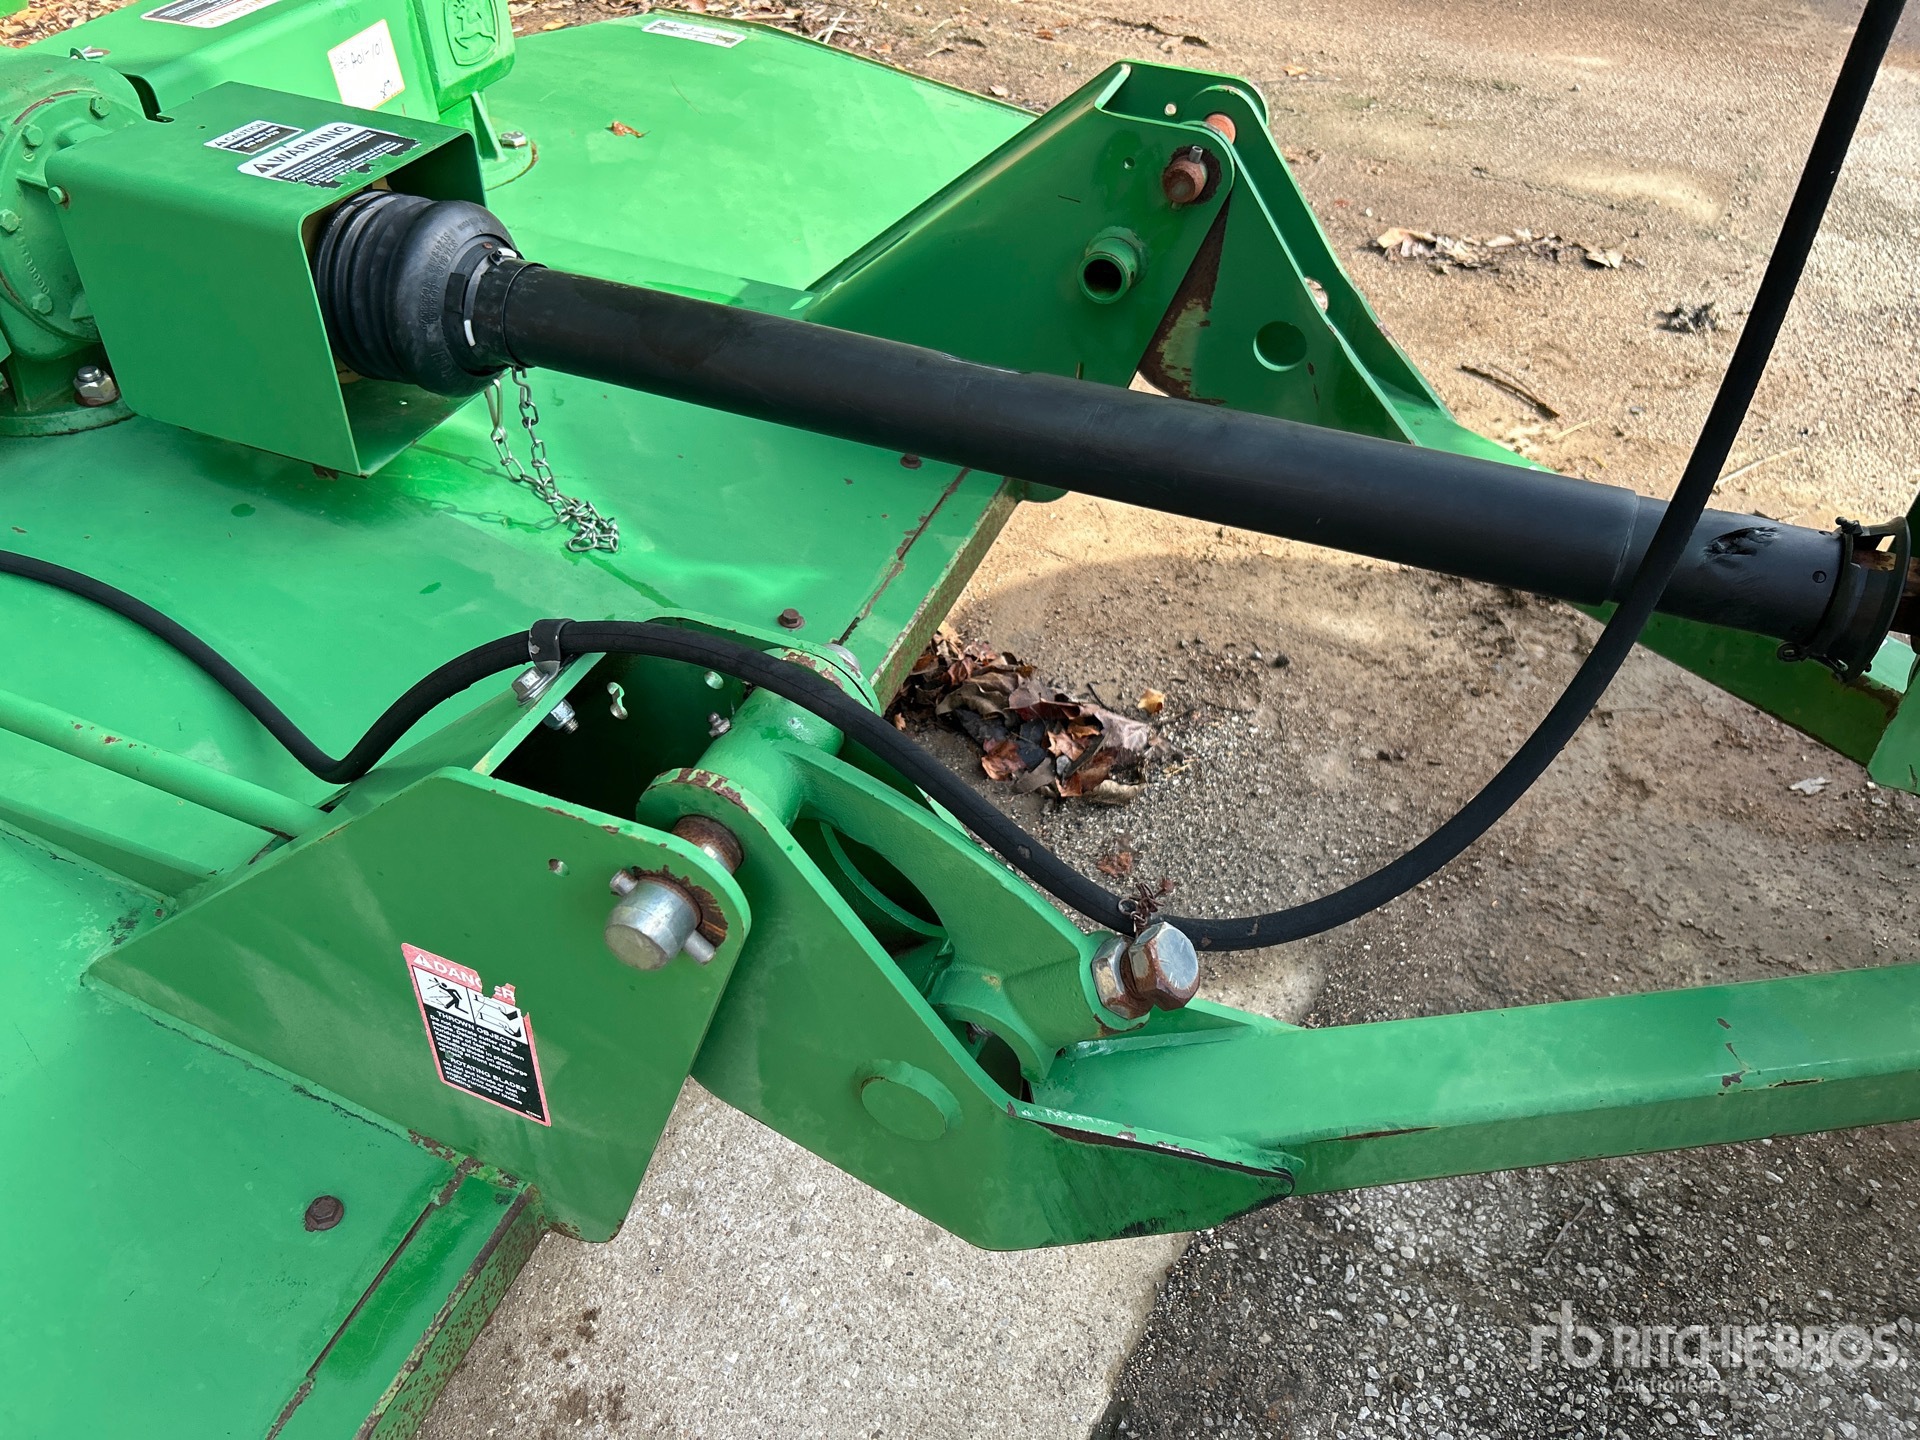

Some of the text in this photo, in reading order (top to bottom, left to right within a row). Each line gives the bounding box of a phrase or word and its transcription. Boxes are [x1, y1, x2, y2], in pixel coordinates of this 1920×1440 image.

[225, 122, 267, 141] CAUTION
[267, 125, 354, 163] WARNING
[429, 1014, 514, 1051] Do not operate cutter near
[432, 1025, 464, 1041] hundreds
[434, 1030, 451, 1041] Keep
[460, 1041, 484, 1054] shields
[437, 1010, 517, 1048] THROWN OBJECTS
[455, 1029, 477, 1042] Debris
[477, 1038, 491, 1047] can
[491, 1043, 500, 1051] be
[500, 1047, 525, 1061] thrown
[437, 1041, 463, 1055] opening
[471, 1054, 487, 1065] front
[487, 1061, 501, 1070] and
[501, 1066, 515, 1076] rear
[449, 1056, 527, 1093] ROTATING BLADES
[466, 1048, 485, 1060] those
[495, 1059, 528, 1077] discharge
[442, 1059, 452, 1067] Do
[452, 1063, 463, 1072] not
[463, 1068, 475, 1076] put
[475, 1073, 496, 1085] hands
[504, 1084, 517, 1093] feet
[443, 1064, 462, 1076] under
[470, 1075, 484, 1085] into
[484, 1081, 503, 1092] cutter
[504, 1088, 518, 1098] with
[445, 1070, 466, 1082] engine
[466, 1078, 492, 1092] running
[500, 1092, 522, 1104] blades
